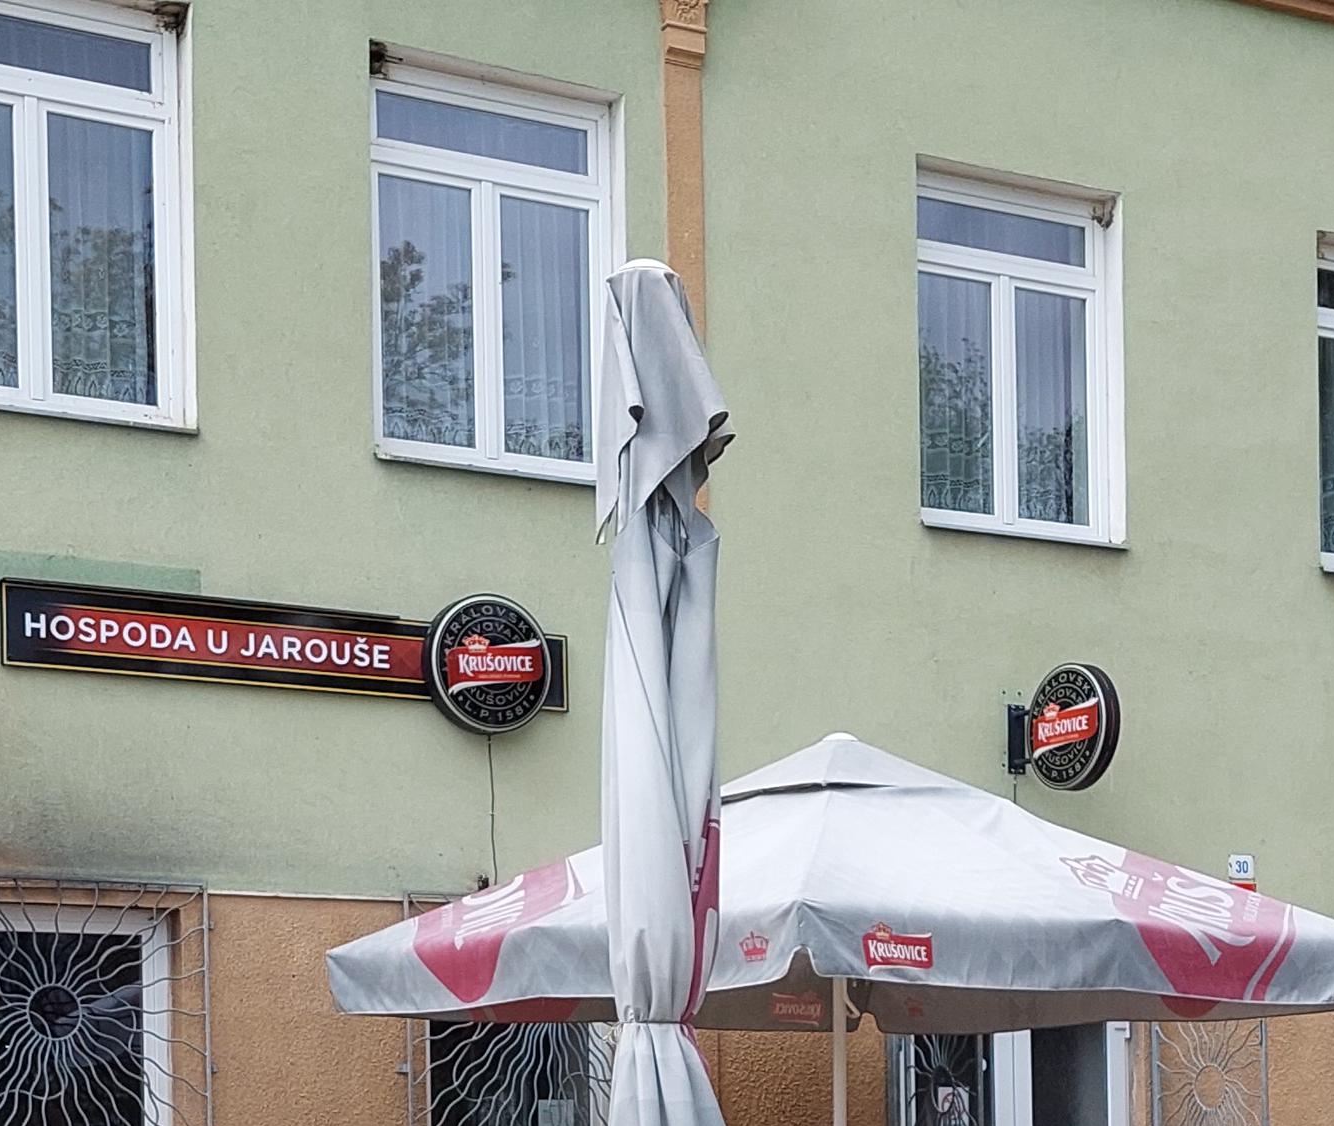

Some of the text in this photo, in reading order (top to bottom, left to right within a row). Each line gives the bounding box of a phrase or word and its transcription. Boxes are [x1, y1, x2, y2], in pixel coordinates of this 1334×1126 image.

[23, 612, 391, 670] HOSPODA U JAROUŠE
[457, 653, 535, 677] KRUŠOVICE
[497, 699, 531, 721] 1581
[1235, 860, 1249, 874] 30
[867, 939, 929, 963] KRUŠOVICE
